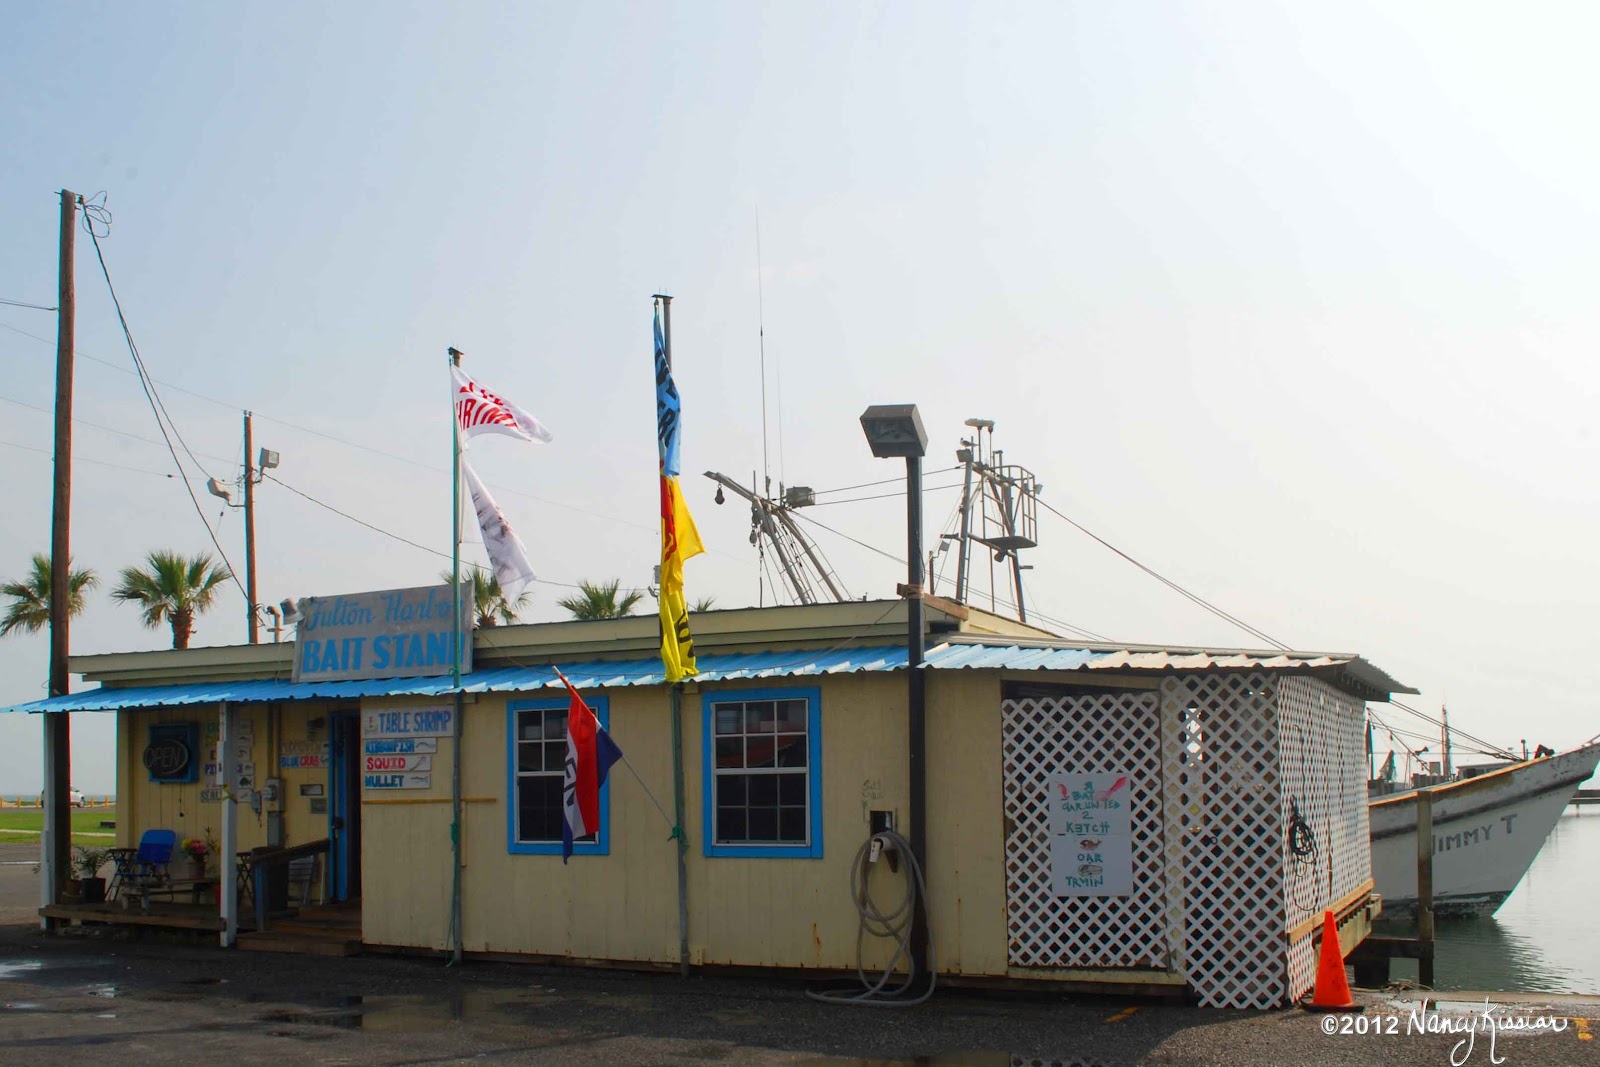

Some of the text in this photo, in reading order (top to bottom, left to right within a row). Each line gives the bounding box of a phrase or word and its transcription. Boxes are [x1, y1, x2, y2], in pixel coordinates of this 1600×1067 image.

[306, 597, 373, 632] Fulton
[303, 637, 366, 674] BAIT
[378, 710, 452, 734] TABLE SHRIMP
[280, 755, 319, 767] BLUE CRAB
[366, 757, 406, 771] SQUID
[364, 775, 405, 788] MULLET
[1082, 811, 1094, 819] 2
[1501, 813, 1517, 834] T
[1077, 853, 1104, 863] OAR
